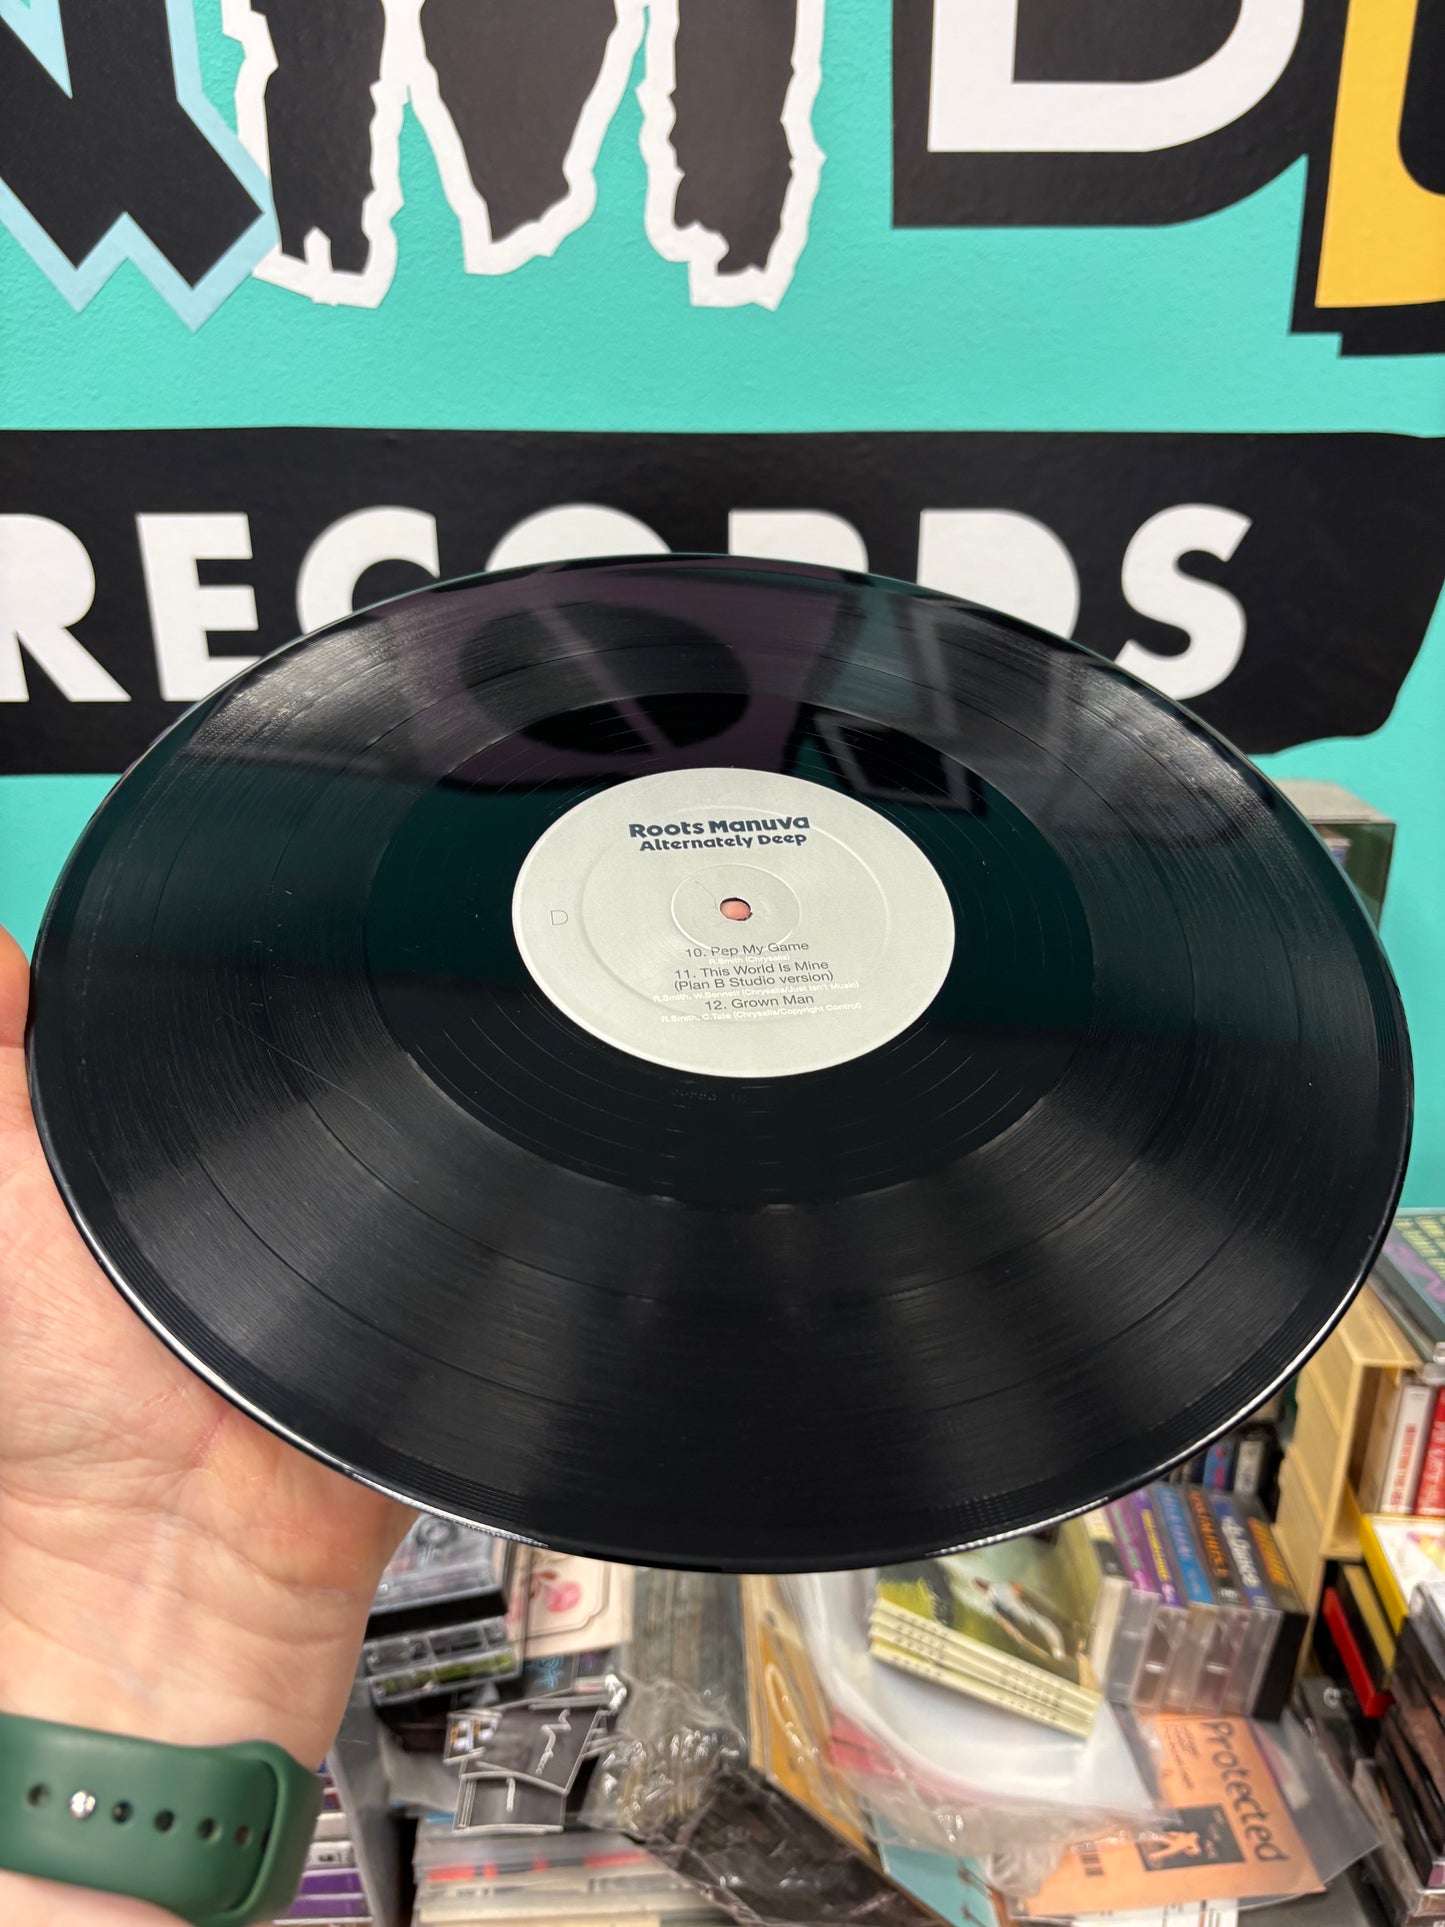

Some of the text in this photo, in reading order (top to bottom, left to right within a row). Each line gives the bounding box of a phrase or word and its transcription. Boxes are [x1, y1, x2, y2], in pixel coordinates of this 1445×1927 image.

[0, 503, 1253, 702] RECDS
[628, 816, 810, 838] Roots Manuva
[639, 834, 807, 851] Alternately Deep
[550, 909, 569, 926] D
[685, 942, 809, 958] 10. Pep My Game
[675, 960, 829, 979] 11. This World Is Mine
[674, 969, 834, 992] (Plan B Studio version)
[705, 994, 815, 1011] 12. Grown Man
[1200, 1720, 1291, 1862] Protected
